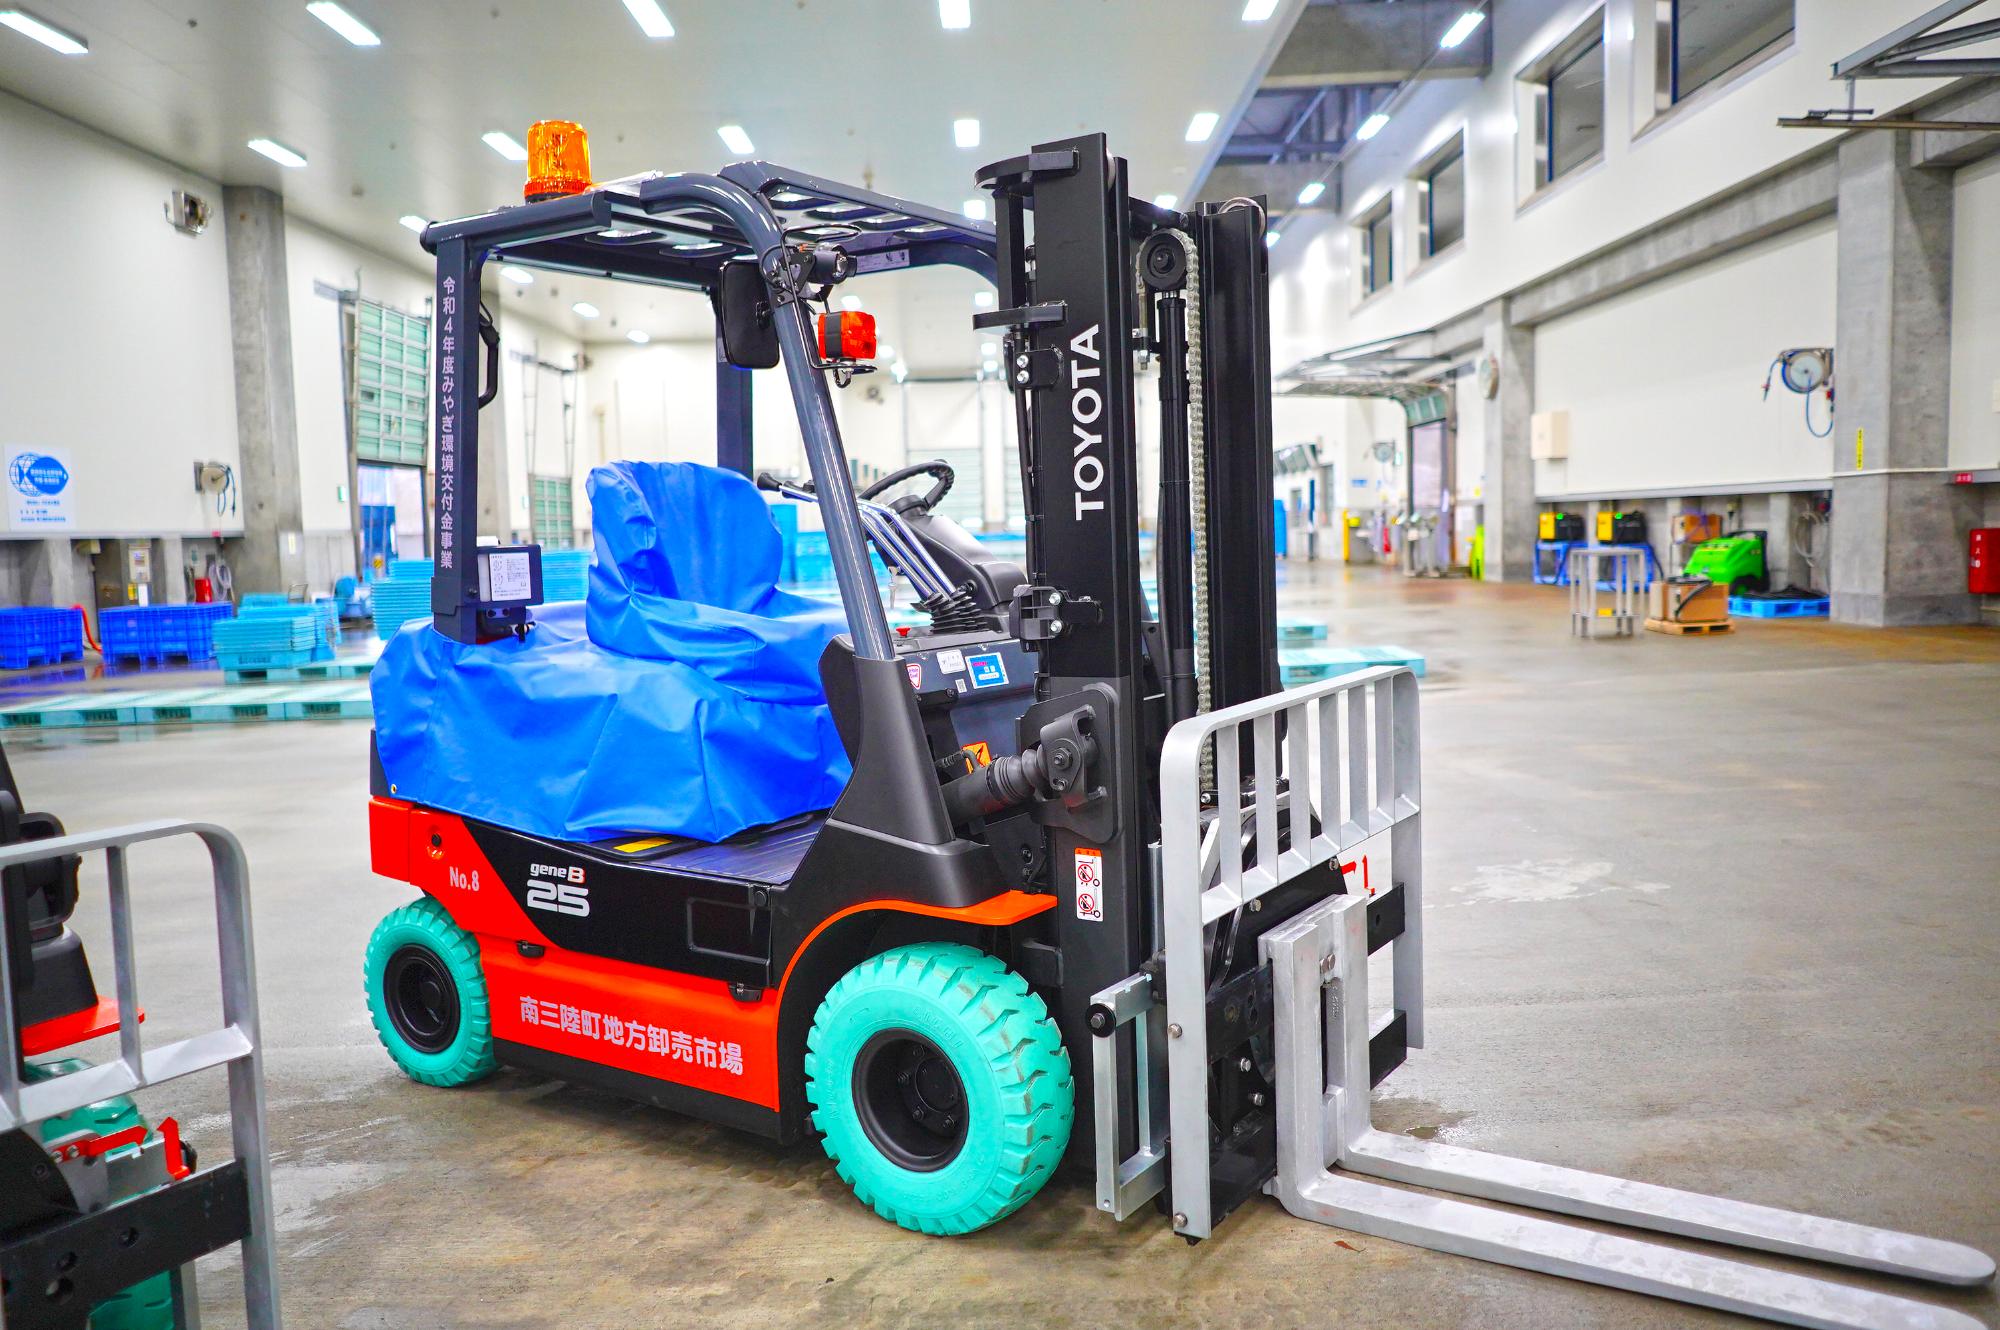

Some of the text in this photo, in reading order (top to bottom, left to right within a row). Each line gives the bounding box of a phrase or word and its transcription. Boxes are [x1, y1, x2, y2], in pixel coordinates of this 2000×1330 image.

[440, 276, 456, 569] 令和4年度みやぎ環境交付金事業
[1070, 323, 1106, 521] TOYOTA
[449, 866, 480, 892] No.8
[526, 879, 591, 918] 25
[519, 995, 744, 1076] 南三陸町地方卸売市場
